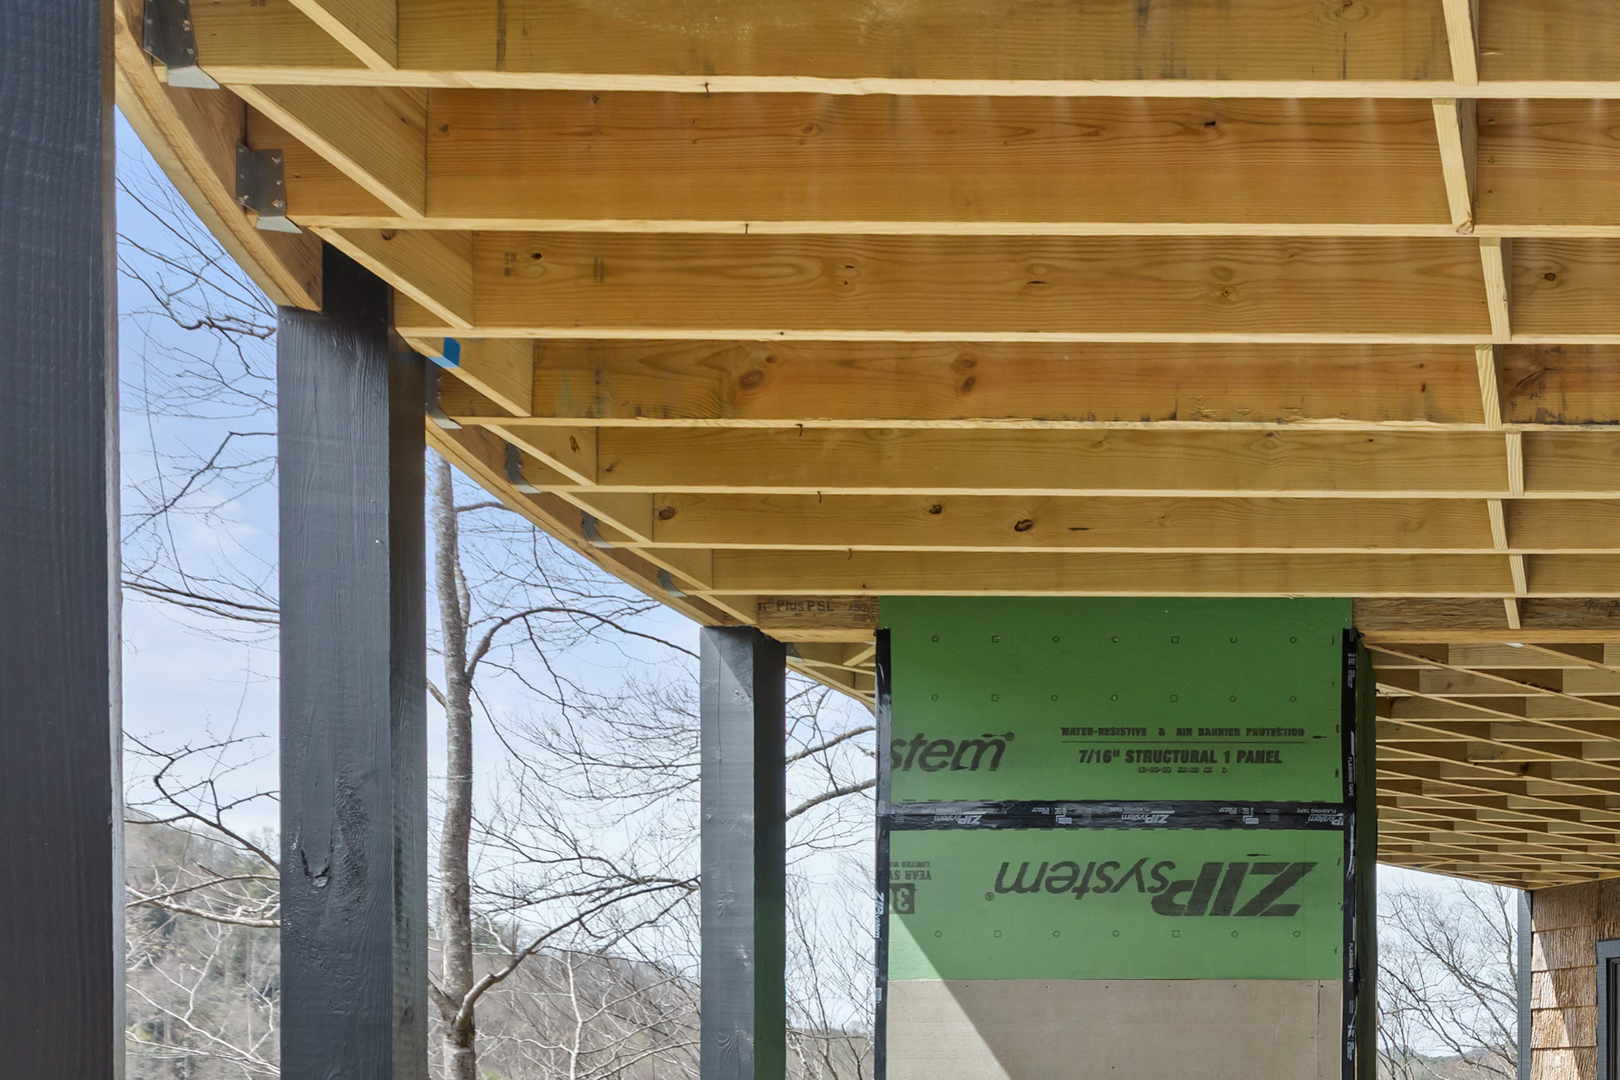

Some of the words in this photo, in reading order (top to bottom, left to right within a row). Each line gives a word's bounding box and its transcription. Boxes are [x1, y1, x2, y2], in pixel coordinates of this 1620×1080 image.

[807, 600, 835, 612] PSL
[1060, 727, 1147, 737] WATER-RESISTIVE
[1176, 728, 1193, 737] AIR
[1198, 728, 1241, 737] BARRIER
[1246, 728, 1305, 737] PROTECTION
[1079, 749, 1120, 764] 7/16"
[1125, 749, 1218, 764] STRUCTURAL
[1223, 749, 1231, 764] 1
[1236, 749, 1283, 764] PANEL
[905, 871, 932, 880] YEAR
